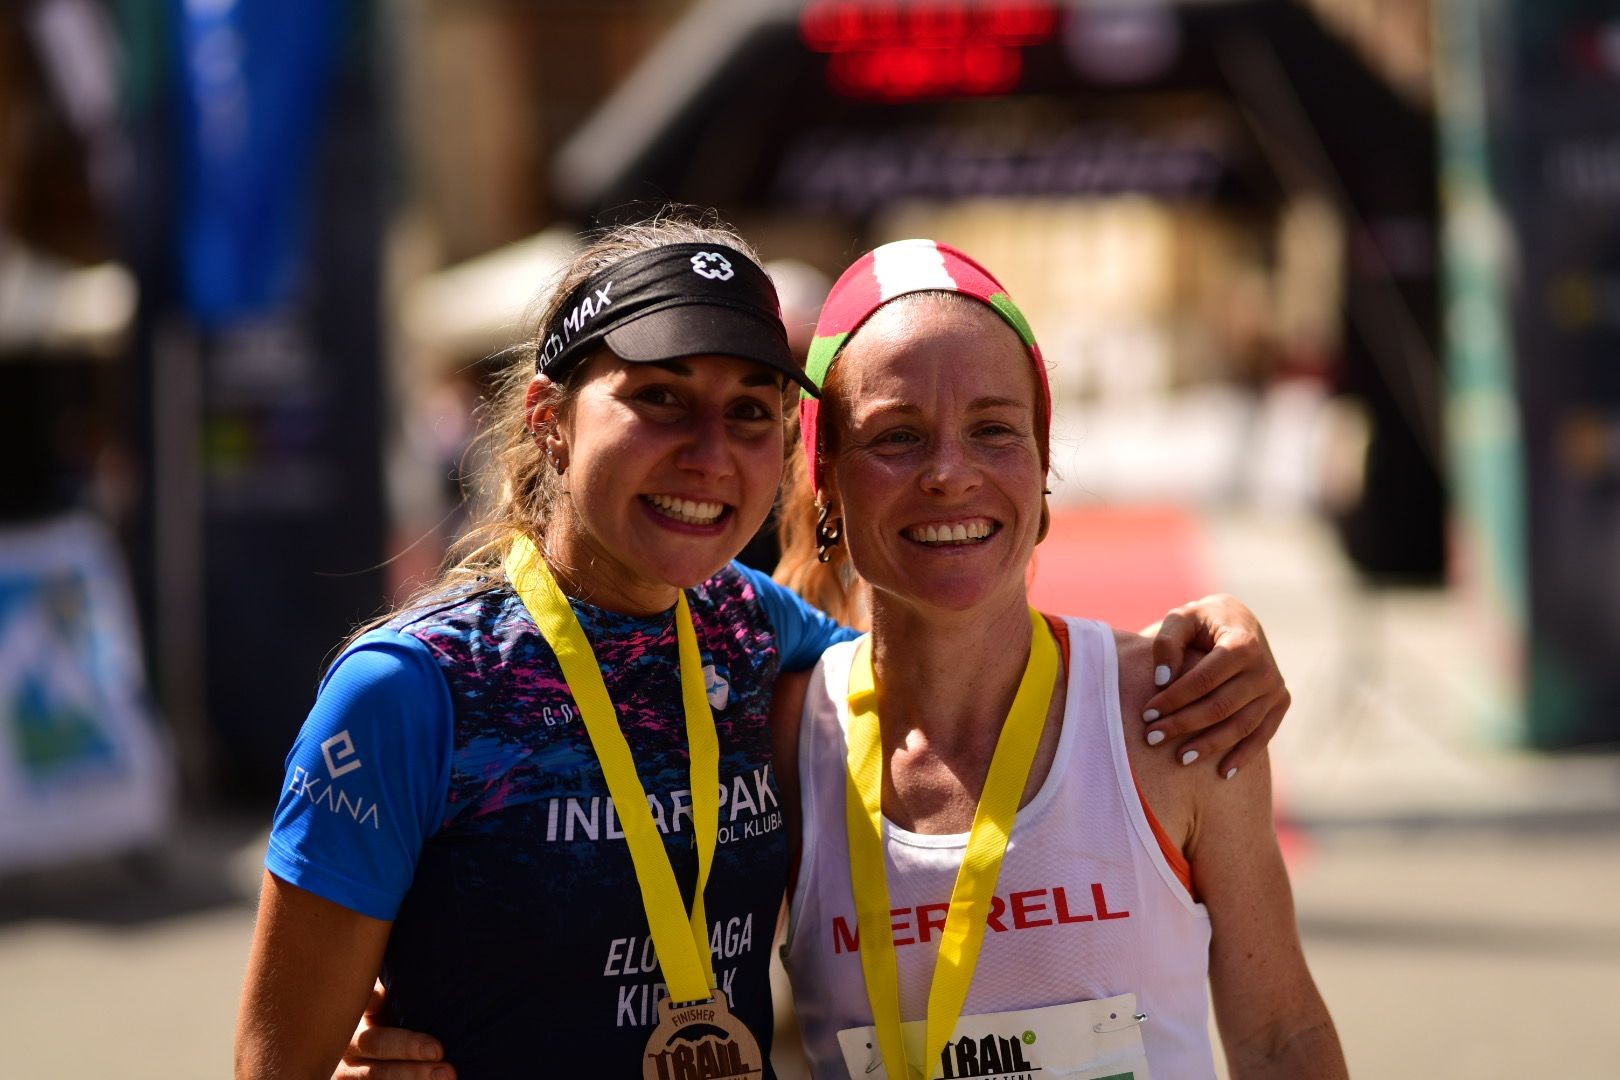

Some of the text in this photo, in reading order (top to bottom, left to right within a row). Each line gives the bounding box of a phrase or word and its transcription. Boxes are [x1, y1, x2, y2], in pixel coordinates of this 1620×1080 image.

[563, 281, 613, 343] MAX
[289, 765, 380, 829] EKANA
[744, 810, 783, 840] KLUBA
[671, 1009, 715, 1027] FINISHER
[648, 1040, 751, 1080] TRAIL
[940, 1033, 1032, 1079] TRAIL
